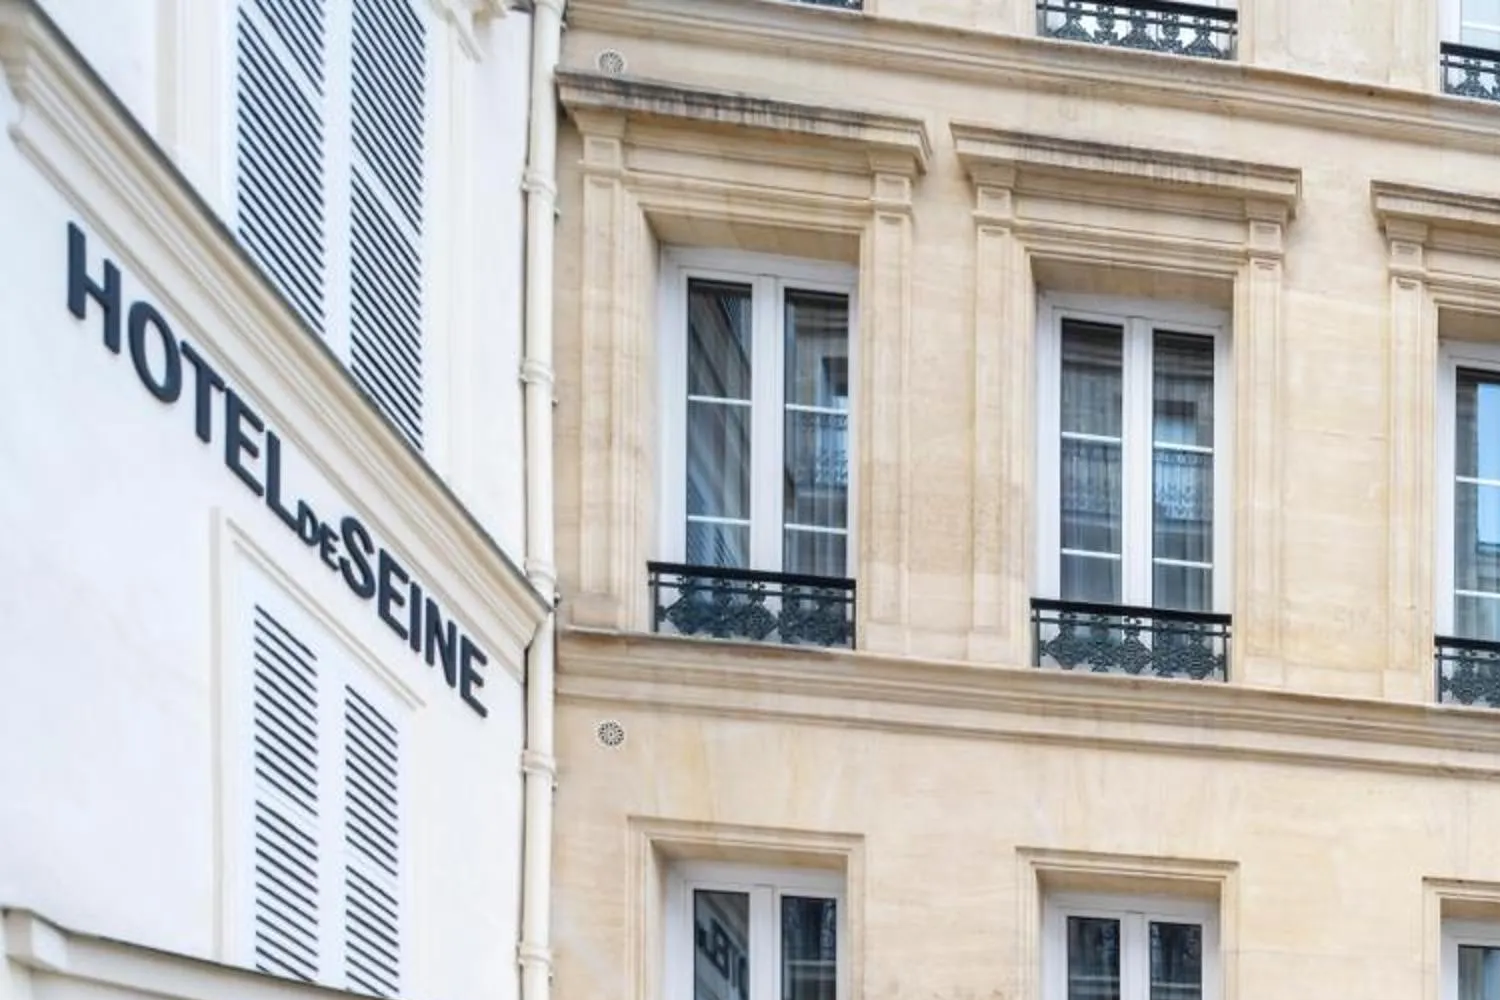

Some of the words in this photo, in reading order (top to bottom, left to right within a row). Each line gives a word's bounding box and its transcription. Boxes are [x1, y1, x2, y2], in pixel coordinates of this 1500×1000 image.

[66, 221, 299, 532] HOTEL
[297, 499, 340, 572] DE
[339, 515, 489, 719] SEINE
